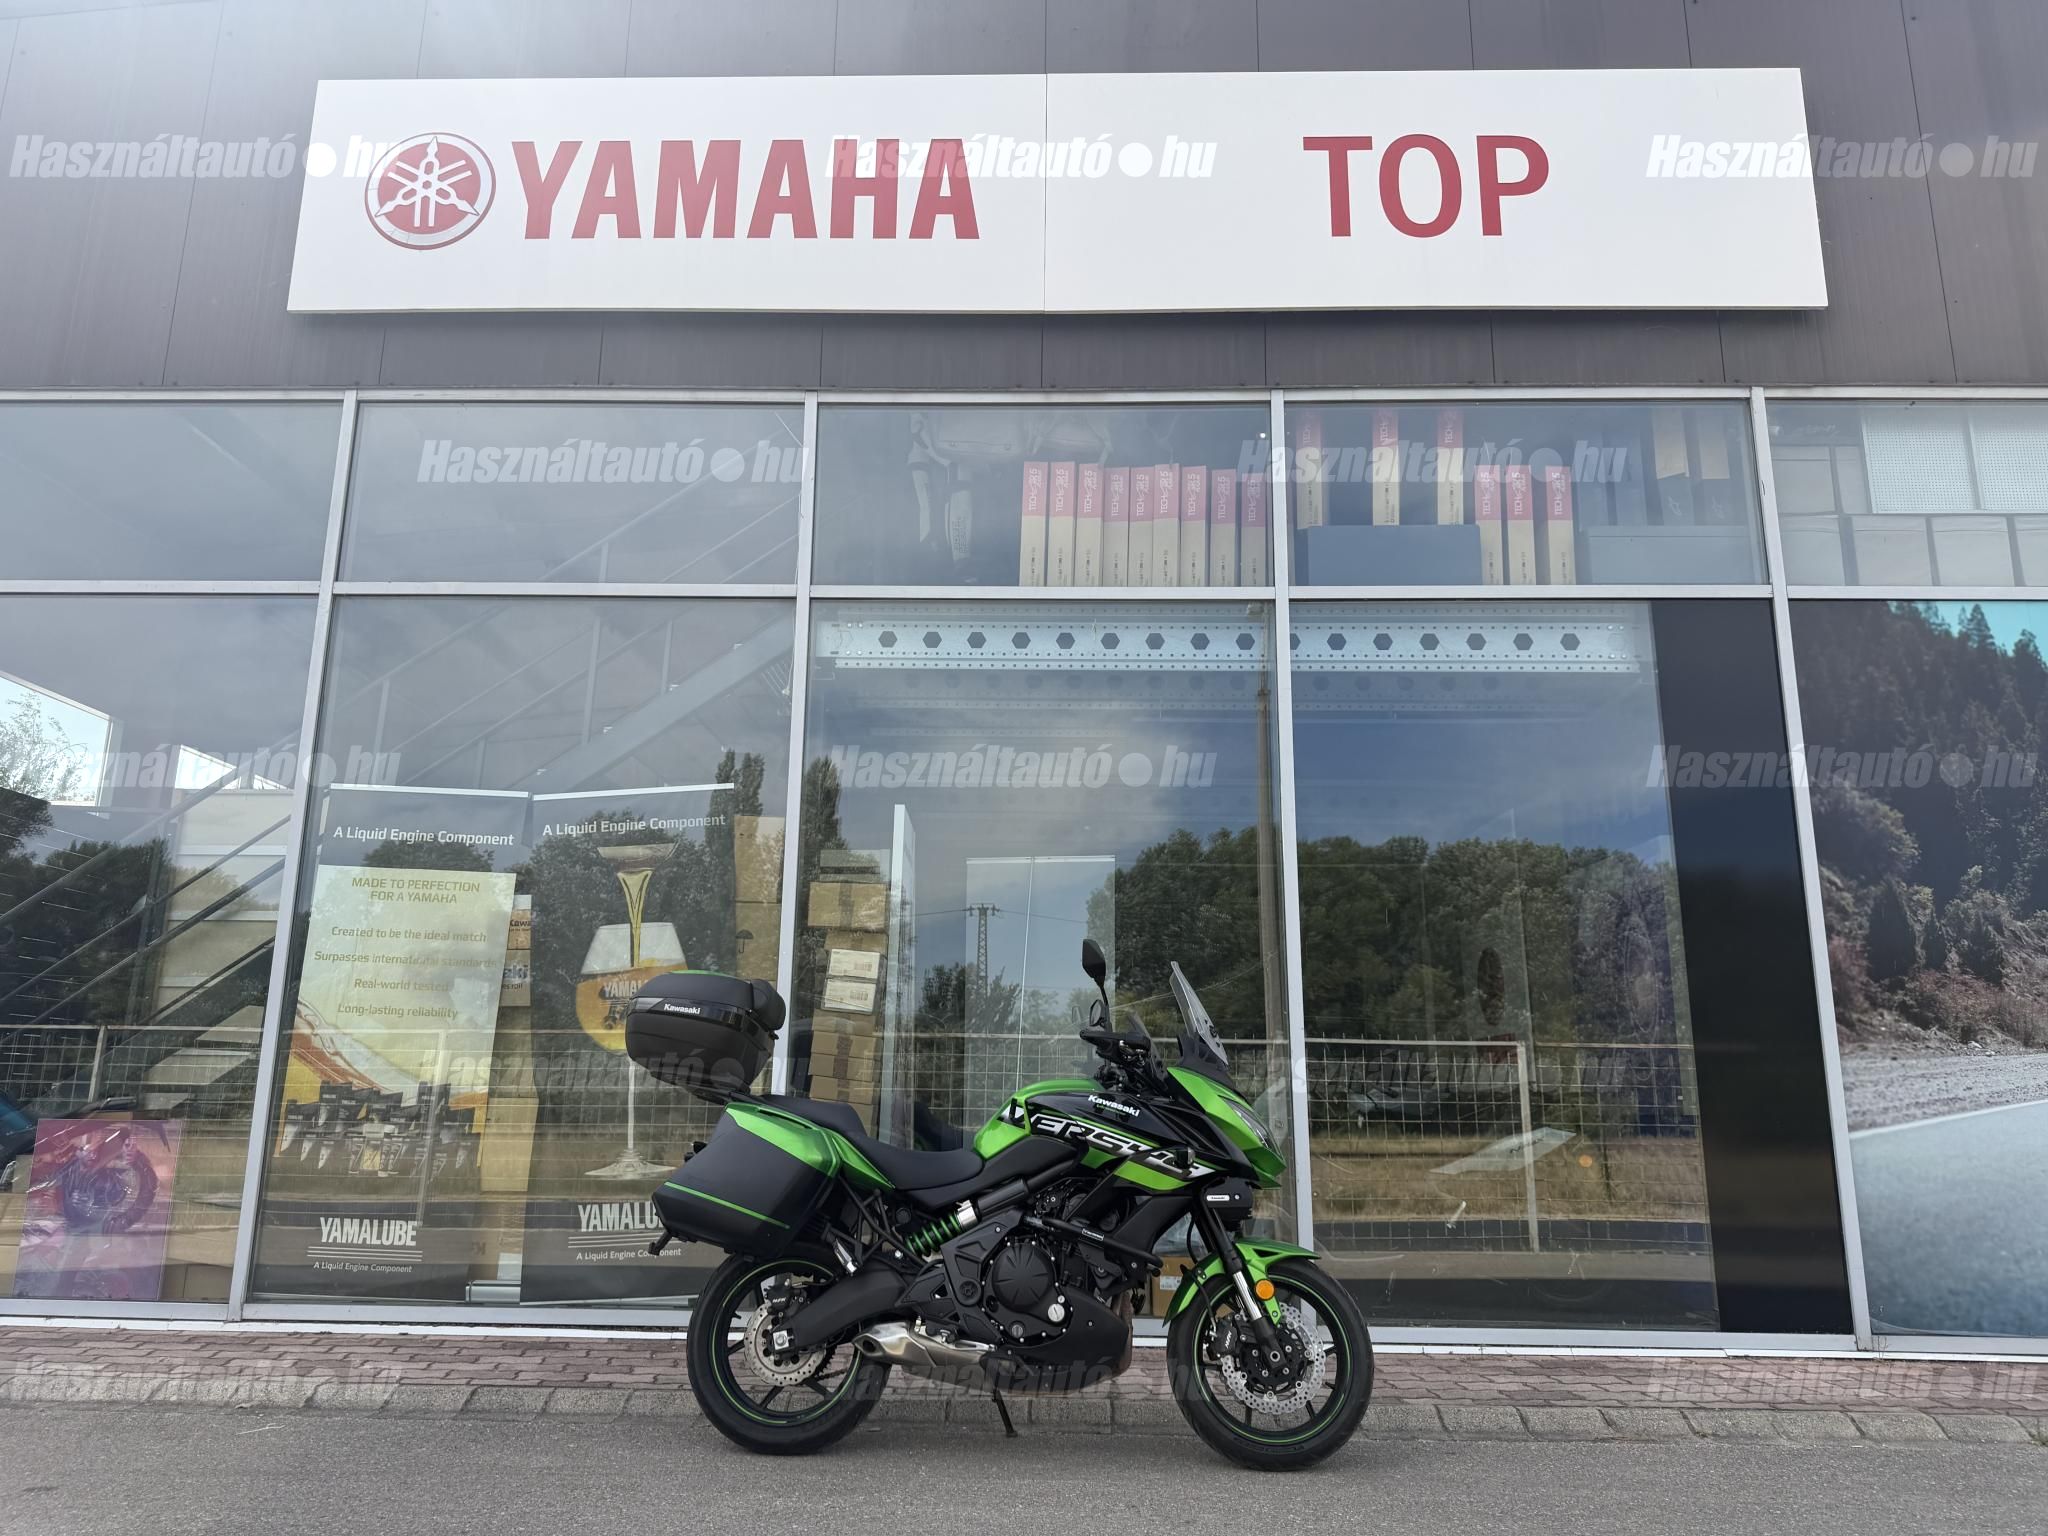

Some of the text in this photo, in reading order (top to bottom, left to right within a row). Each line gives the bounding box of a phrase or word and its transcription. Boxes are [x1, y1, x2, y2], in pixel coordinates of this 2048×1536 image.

[511, 134, 1549, 240] YAMAHA TOP
[543, 813, 726, 838] A Liquid Engine Component
[333, 826, 515, 846] A Liquid Engine Component
[351, 877, 480, 892] MADE TO PERFECTION
[370, 890, 457, 904] FOR A YAMAHA
[331, 926, 487, 943] Created to be the ideal match
[314, 951, 369, 965] Surpasses
[354, 978, 449, 992] Real-world tested
[337, 1003, 459, 1020] Long-lasting reliability
[664, 1003, 701, 1015] Kawasaki
[1088, 1094, 1140, 1117] Kawasaki
[578, 1201, 664, 1232] YAMALU
[320, 1216, 417, 1247] YAMALUBE
[576, 1248, 682, 1261] A Liquid Engine Coonent
[313, 1261, 413, 1274] A Liquid Engine Component
